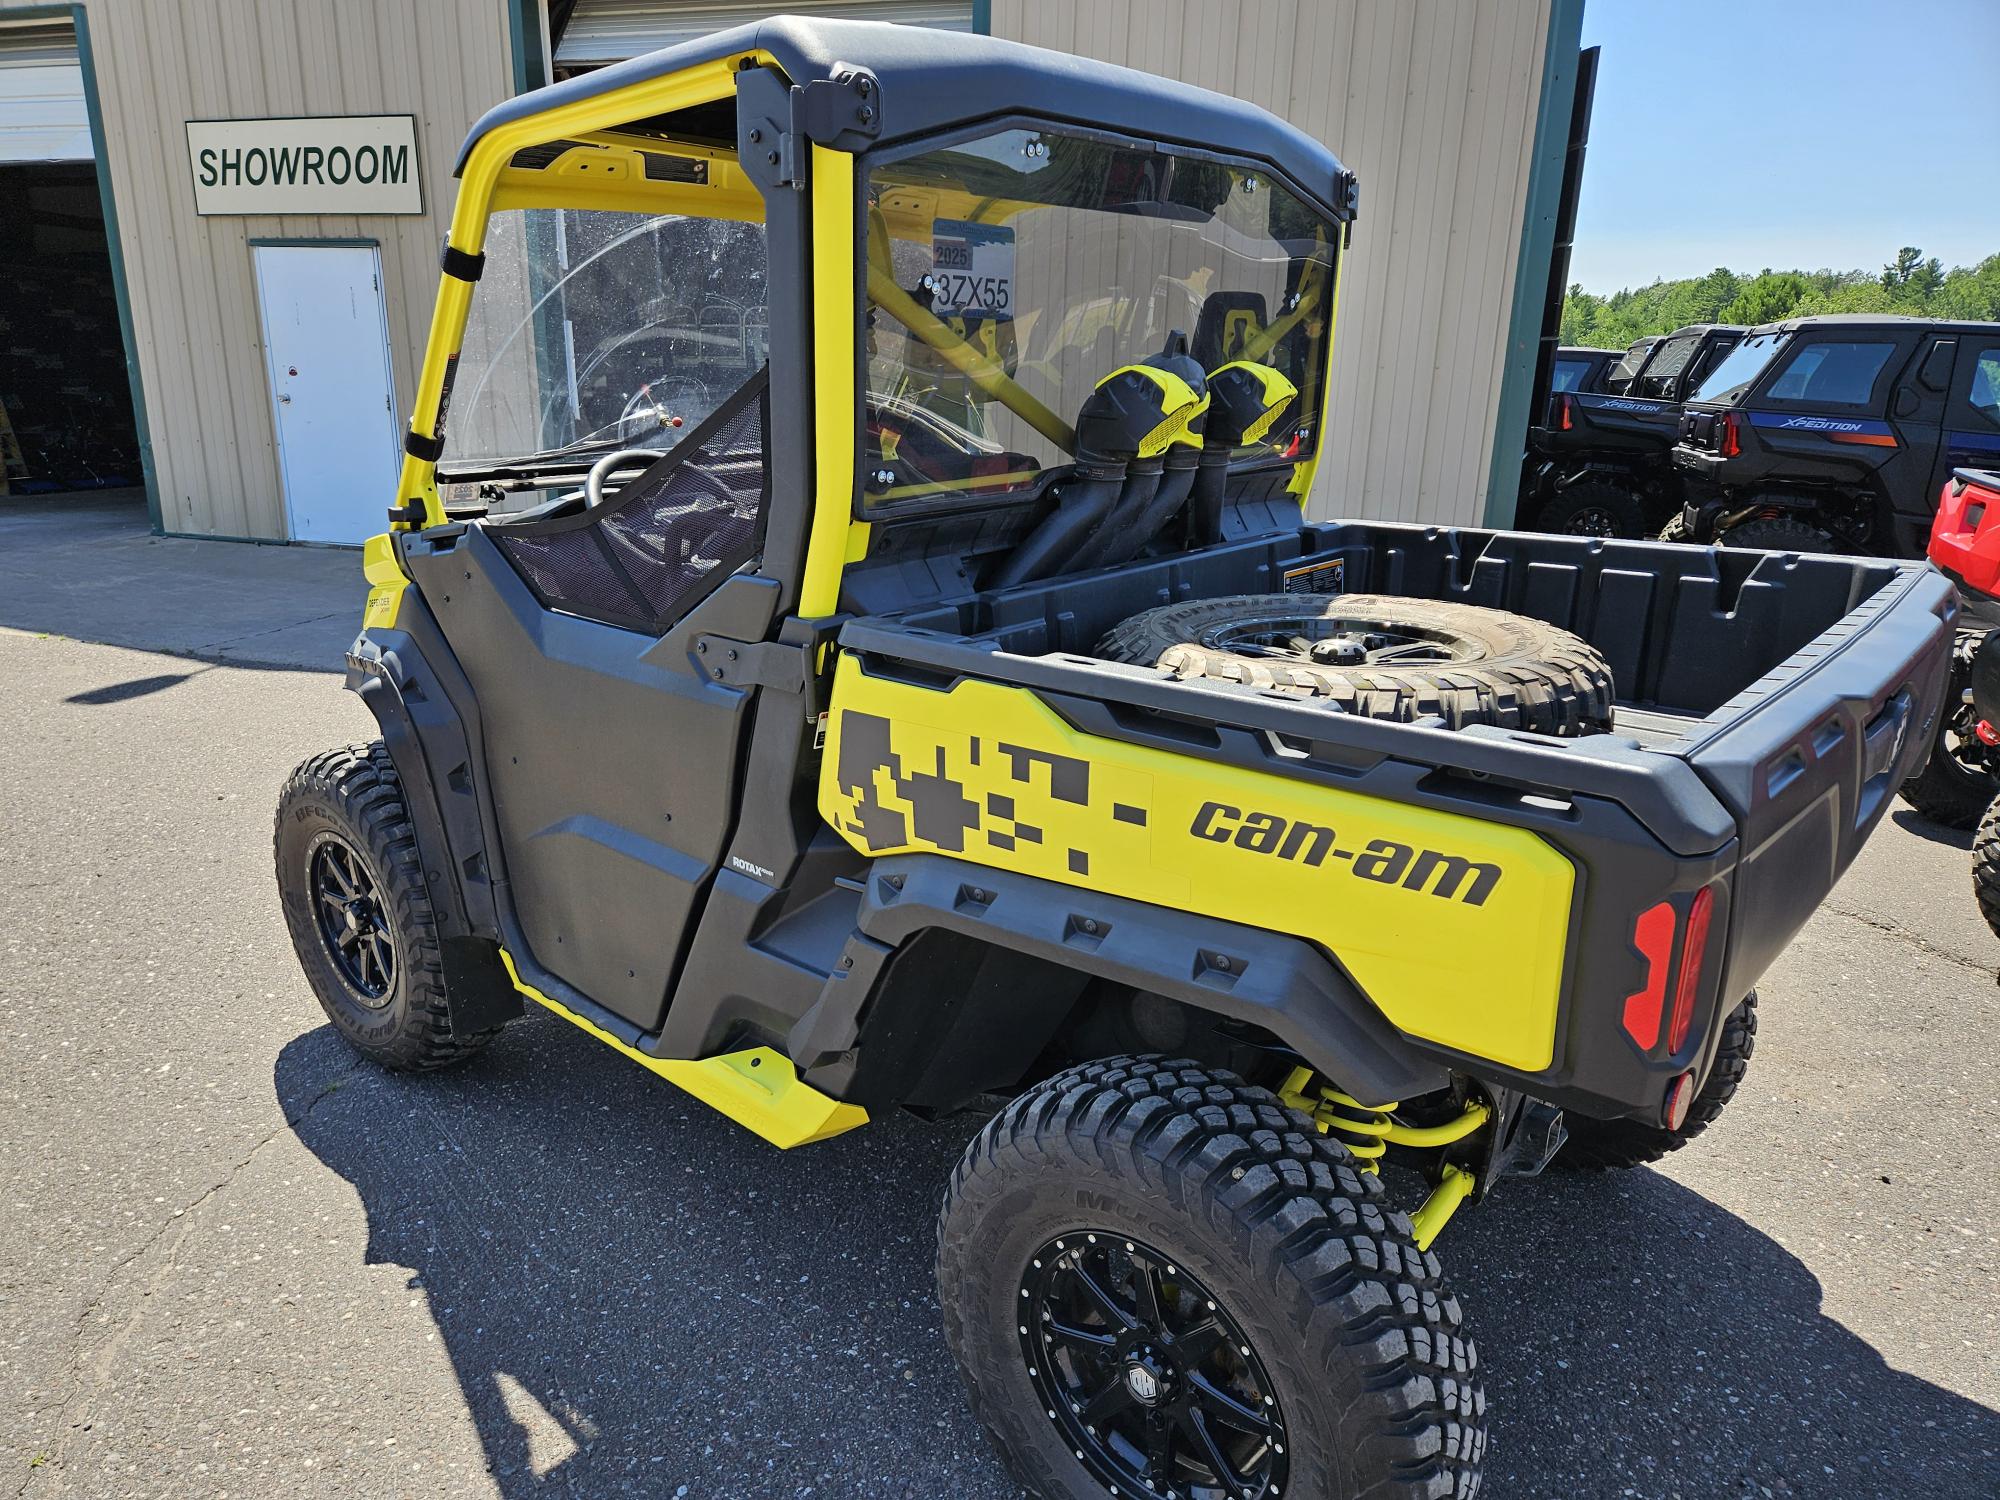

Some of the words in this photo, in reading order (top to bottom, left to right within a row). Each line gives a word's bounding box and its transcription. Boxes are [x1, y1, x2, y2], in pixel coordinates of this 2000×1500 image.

[199, 145, 408, 187] SHOWROOM
[935, 246, 968, 265] 2025
[937, 273, 1009, 308] 3ZX55
[1598, 399, 1661, 412] XPEDITION
[1779, 416, 1863, 431] XPEDITION
[1190, 801, 1502, 907] can-am
[732, 855, 762, 877] ROTAX
